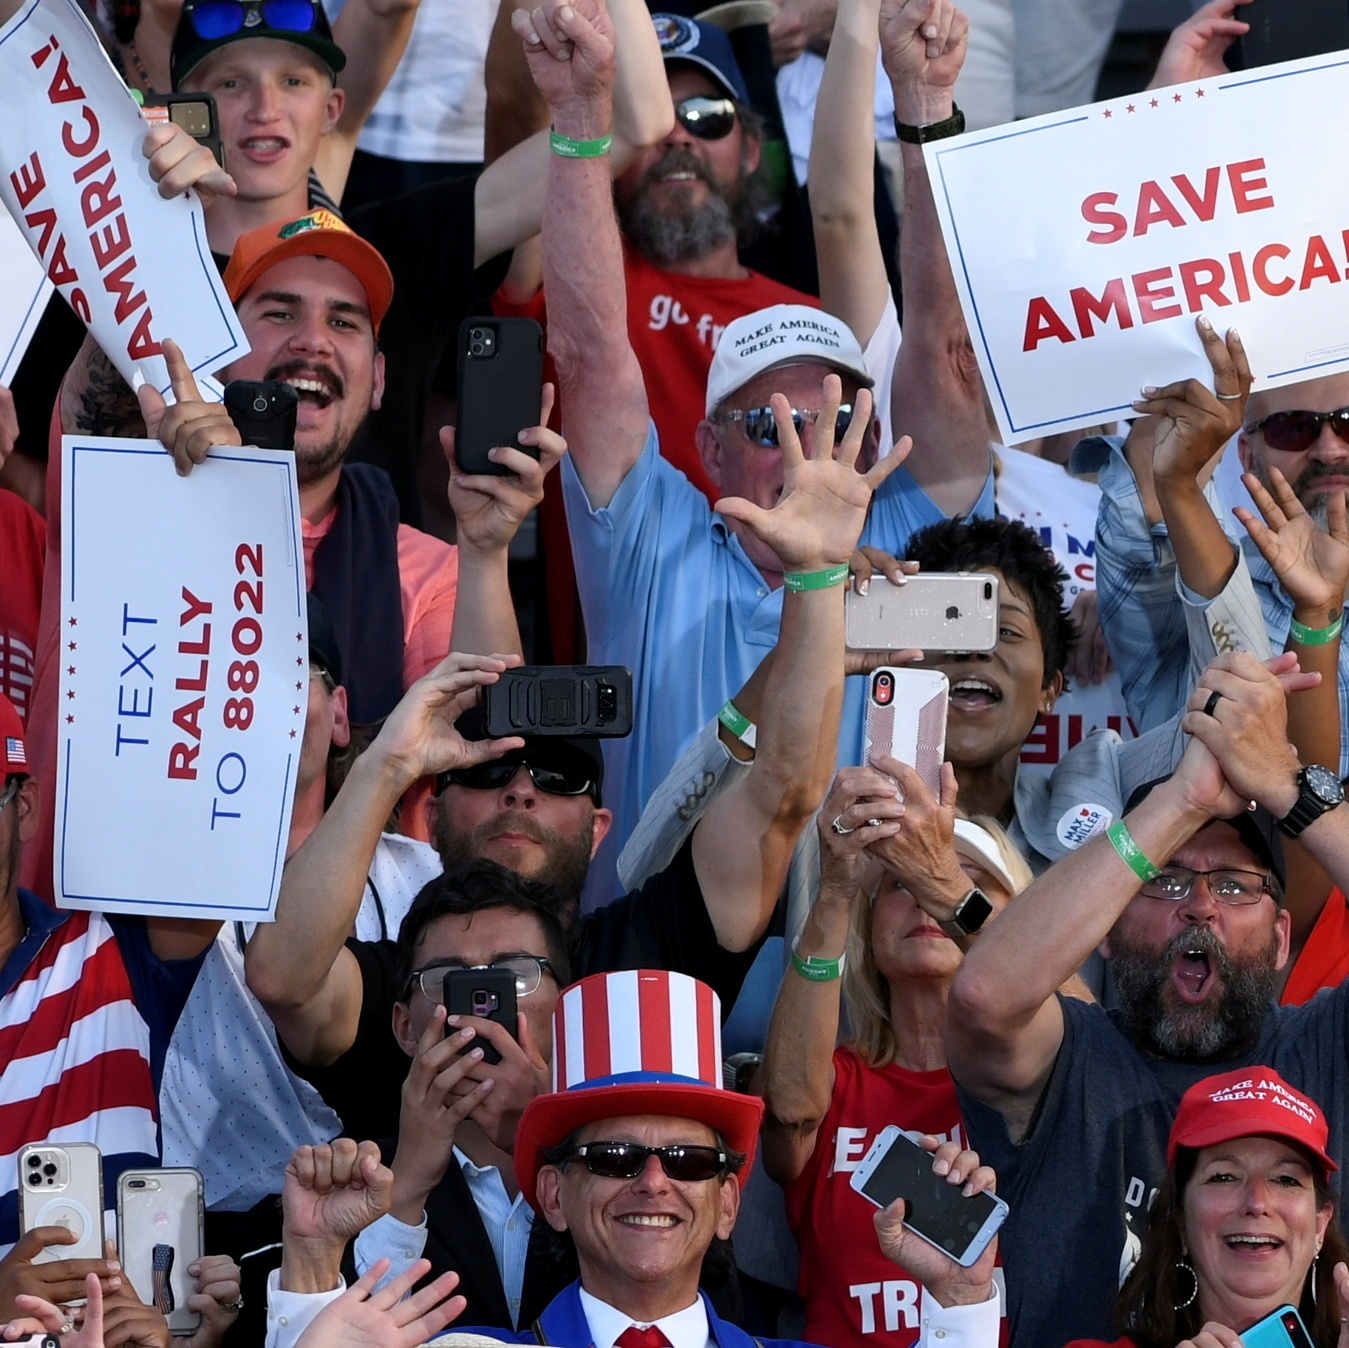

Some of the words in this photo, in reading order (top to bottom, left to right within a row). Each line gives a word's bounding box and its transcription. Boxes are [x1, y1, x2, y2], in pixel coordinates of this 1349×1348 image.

[31, 34, 164, 363] AMERICA!
[1081, 158, 1275, 245] SAVE
[9, 150, 93, 328] SAVE
[734, 323, 774, 348] MAKE
[779, 319, 841, 339] AMERICA
[740, 334, 787, 357] GREAT
[796, 333, 841, 349] AGAIN
[223, 542, 264, 732] 88022
[115, 602, 158, 757] TEXT
[167, 585, 213, 781] RALLY
[211, 752, 247, 831] TO
[1063, 818, 1085, 841] MAX
[1074, 811, 1101, 844] MILLER
[1209, 1080, 1253, 1098] MAKE
[1257, 1080, 1317, 1118] AMERICA
[1212, 1091, 1267, 1103] GREAT
[1271, 1096, 1314, 1125] AGAIN
